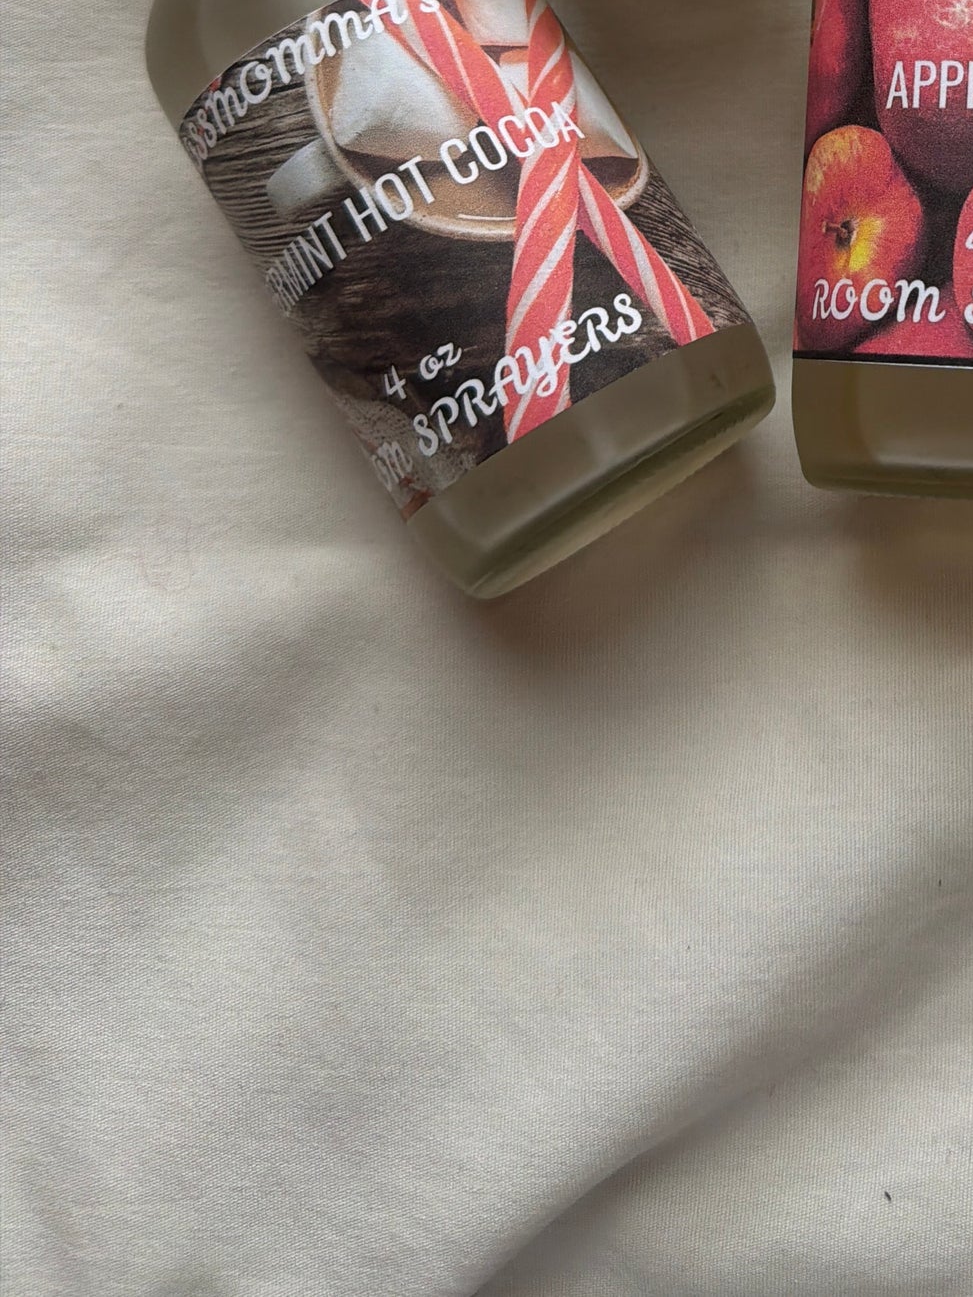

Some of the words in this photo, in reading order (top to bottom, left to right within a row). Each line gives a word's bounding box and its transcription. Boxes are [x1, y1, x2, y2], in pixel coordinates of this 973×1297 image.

[343, 155, 436, 243] HOT
[439, 101, 586, 185] COCOA
[812, 278, 946, 324] ROOM
[384, 365, 407, 400] 4
[419, 342, 463, 381] oz
[412, 293, 643, 458] SPRAYERS
